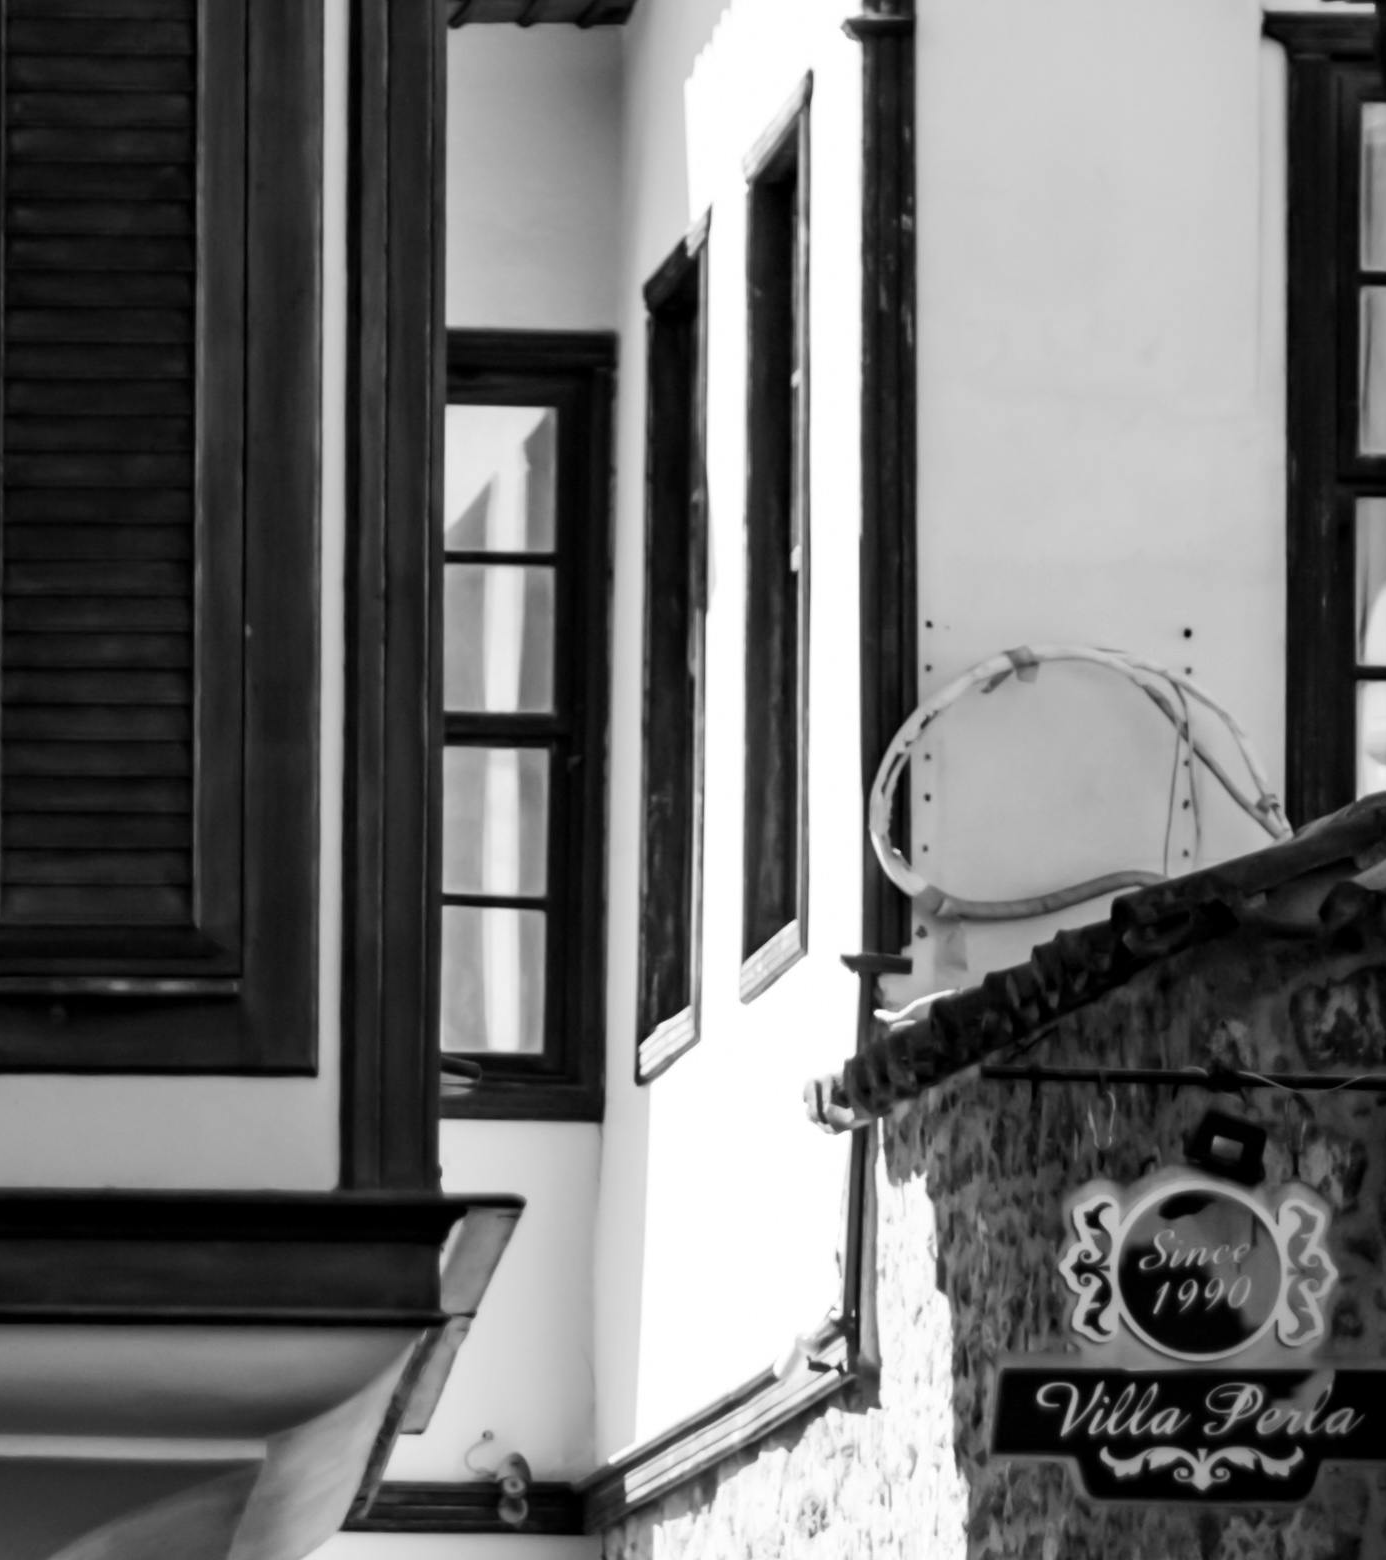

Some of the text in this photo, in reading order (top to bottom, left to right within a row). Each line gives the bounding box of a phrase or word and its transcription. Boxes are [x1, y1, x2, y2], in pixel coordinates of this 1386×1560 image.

[1138, 1229, 1252, 1272] Since
[1152, 1276, 1253, 1316] 1990
[1036, 1378, 1366, 1438] Villa Perla
